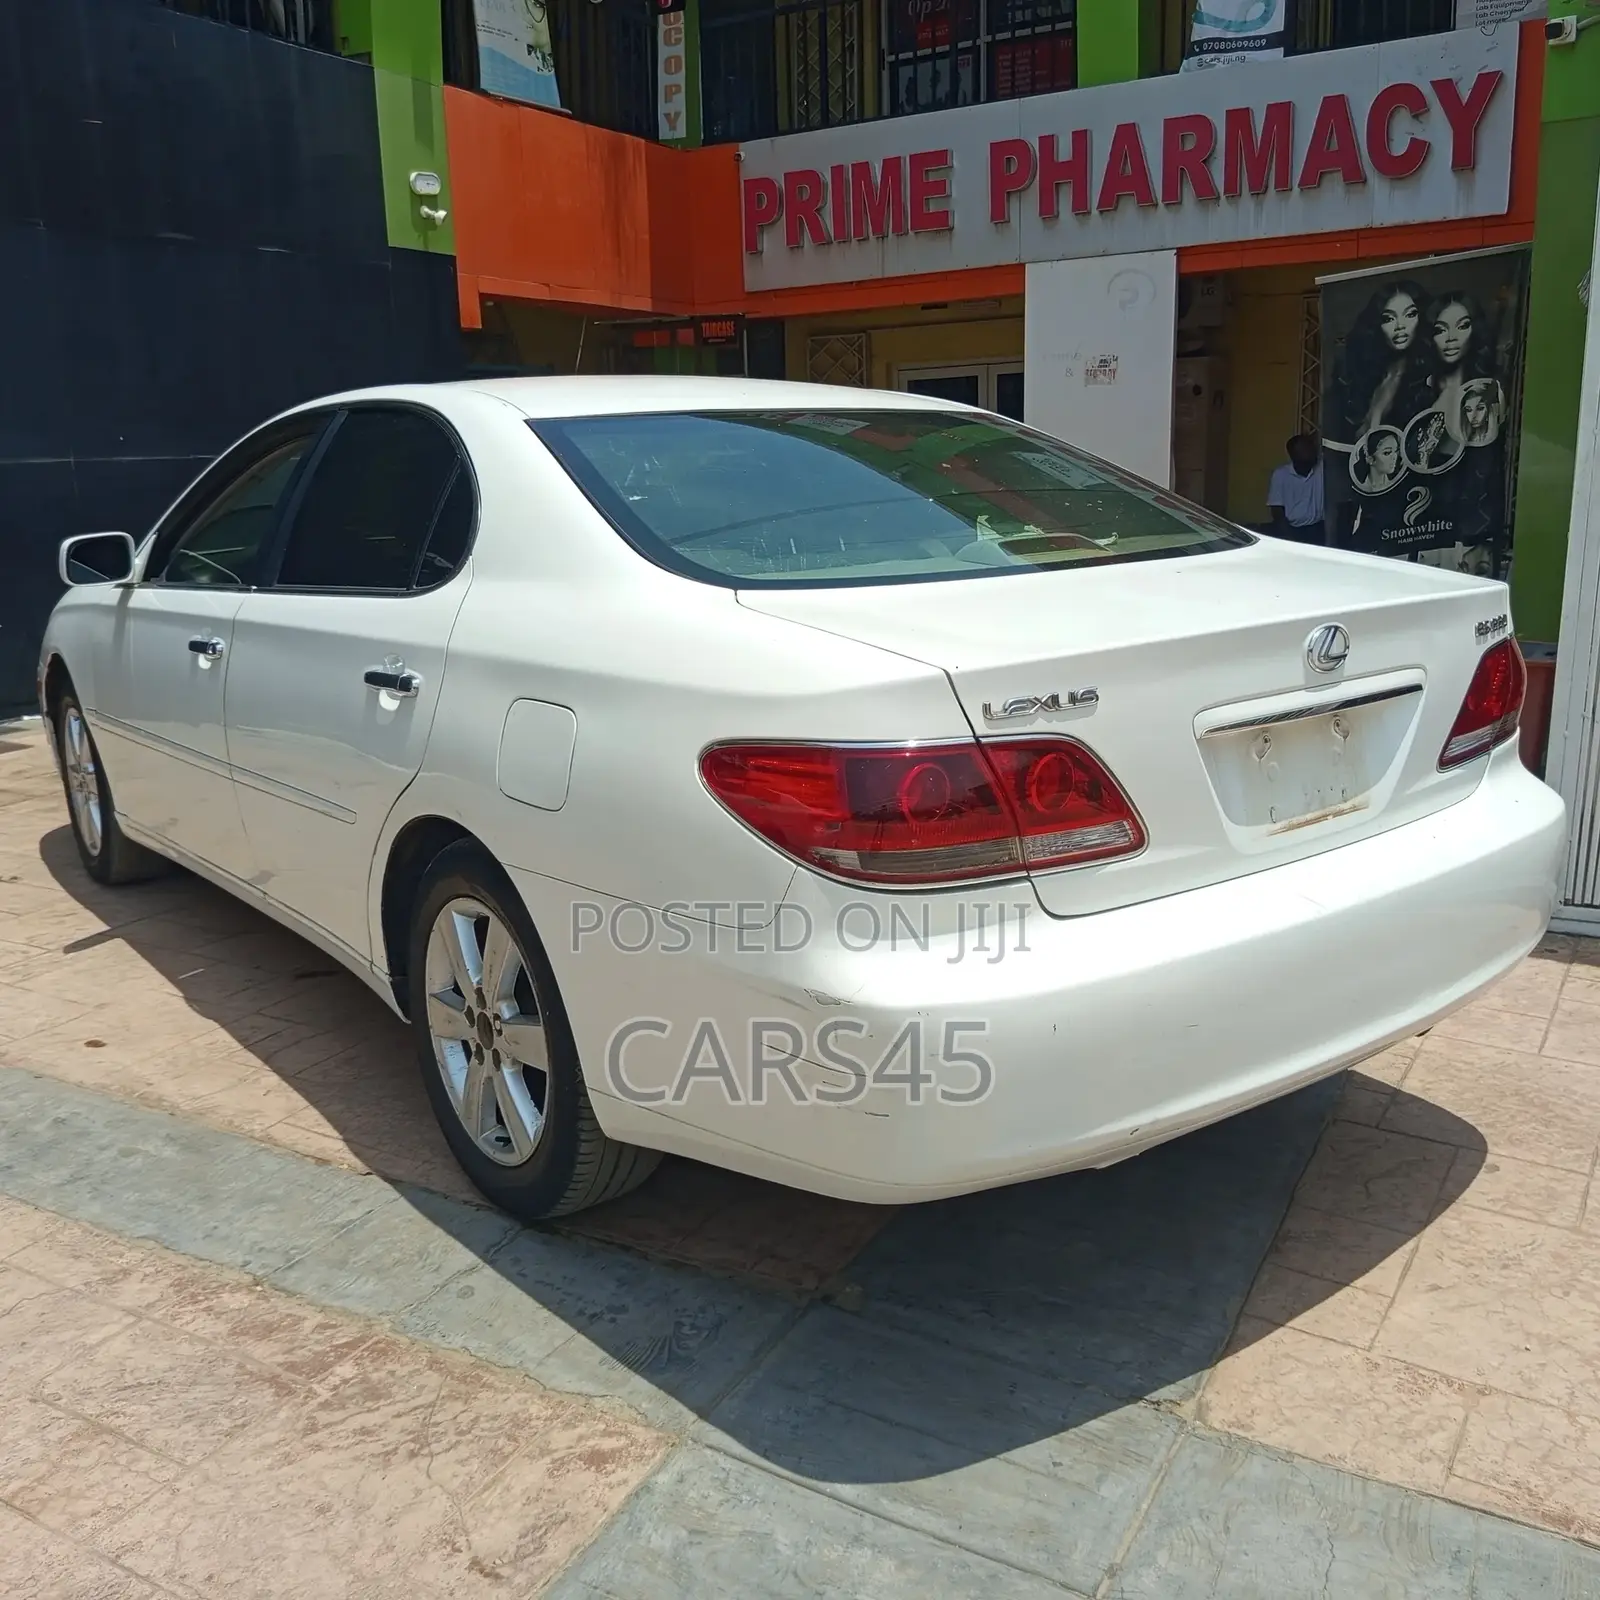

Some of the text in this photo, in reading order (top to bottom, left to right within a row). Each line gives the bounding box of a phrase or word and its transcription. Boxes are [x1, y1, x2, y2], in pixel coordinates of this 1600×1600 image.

[1202, 38, 1267, 51] 07080609609
[743, 70, 1503, 254] PRIME PHARMACY
[1381, 519, 1453, 541] Snowwhite
[1397, 536, 1413, 545] HAIR
[982, 685, 1100, 721] LEXUS
